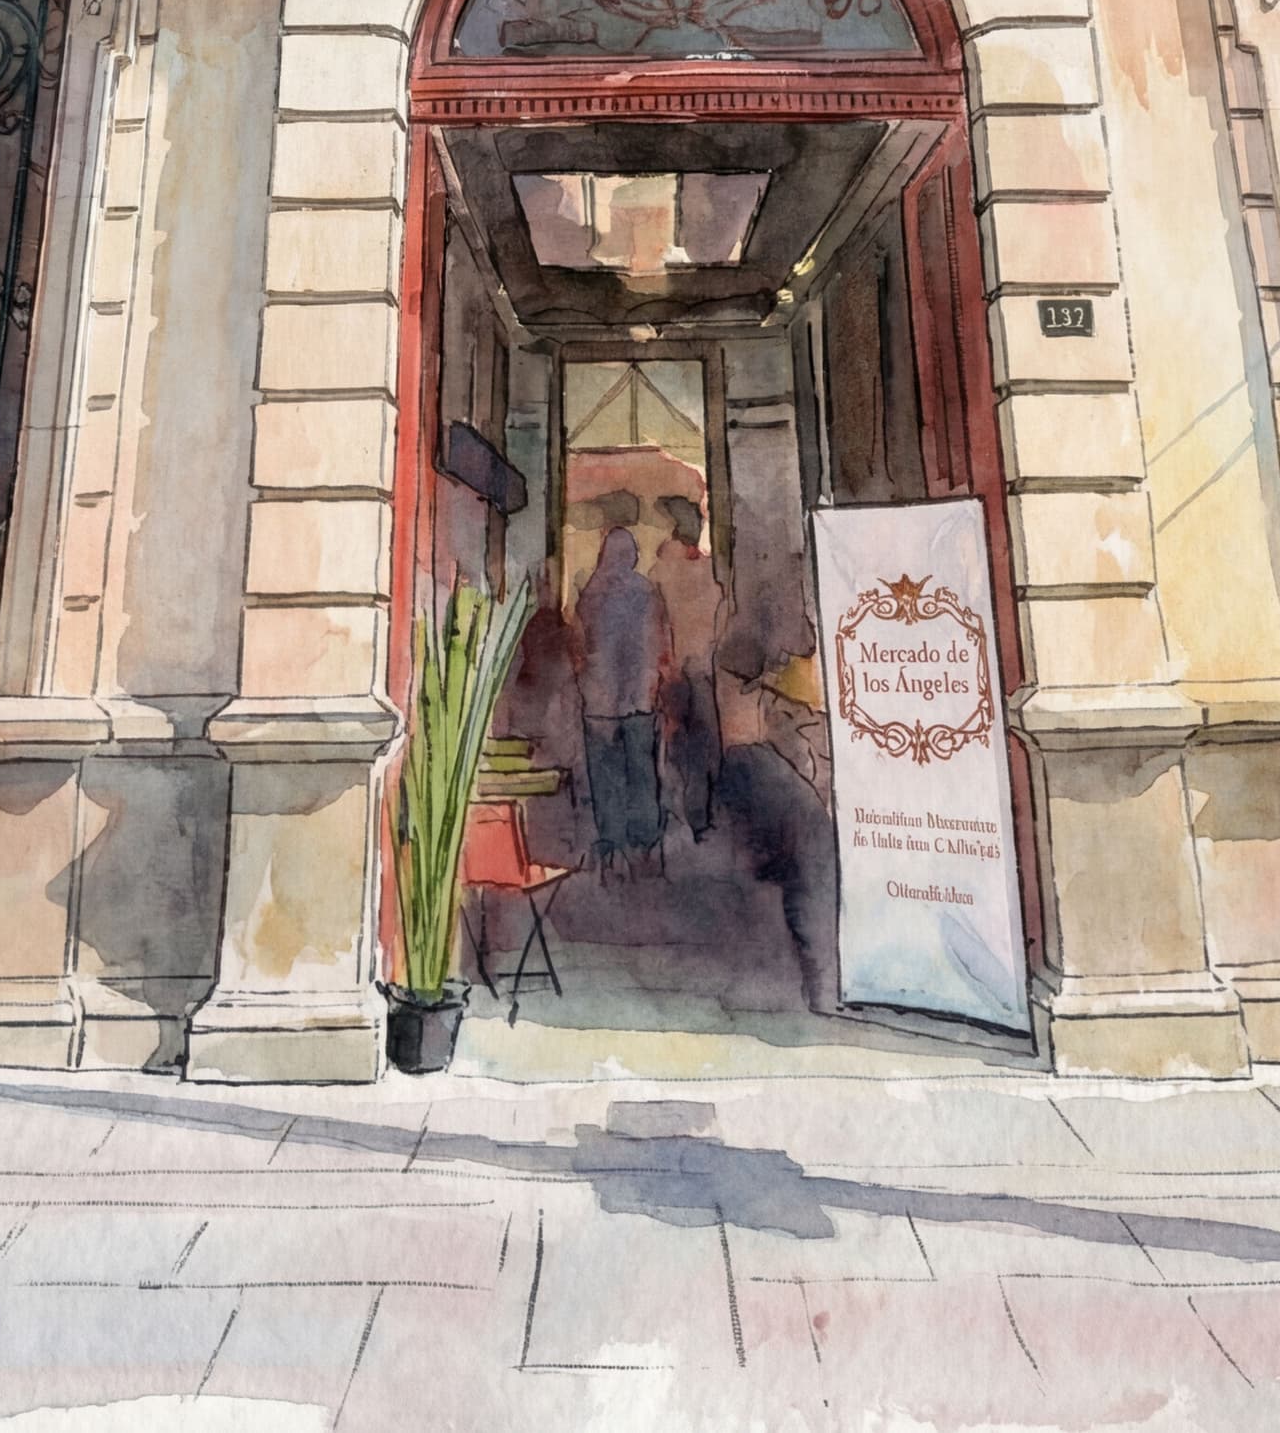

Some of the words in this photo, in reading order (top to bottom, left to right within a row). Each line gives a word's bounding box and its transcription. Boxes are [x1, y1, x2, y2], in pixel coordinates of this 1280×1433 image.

[859, 641, 941, 664] Mercado
[946, 639, 970, 664] de
[862, 671, 890, 694] los
[895, 665, 969, 701] Ángeles
